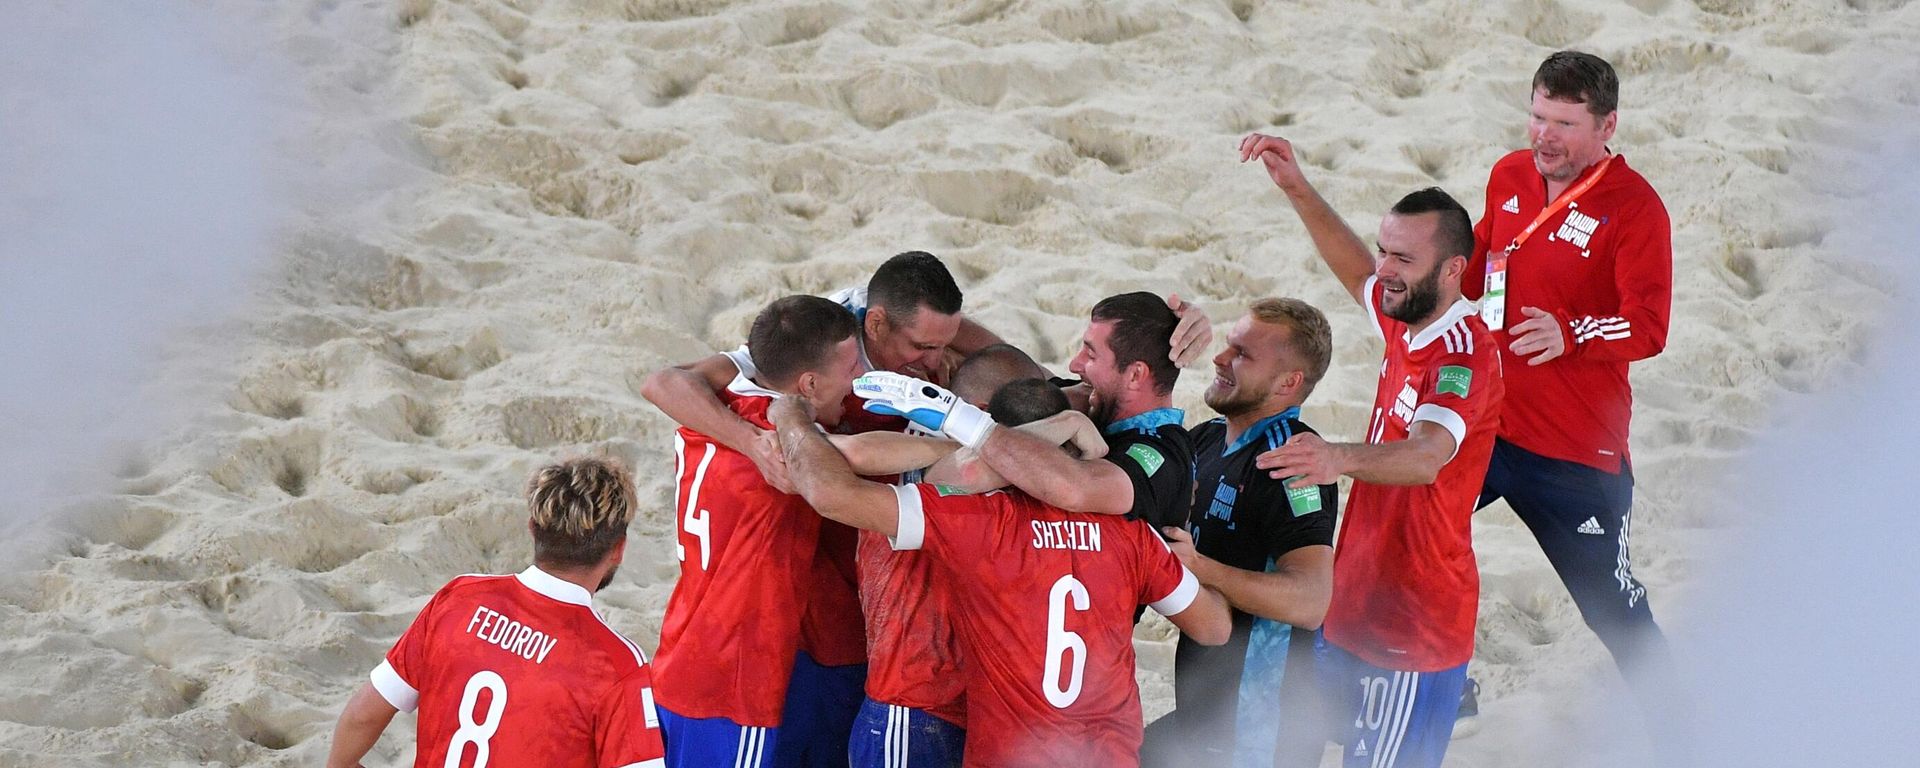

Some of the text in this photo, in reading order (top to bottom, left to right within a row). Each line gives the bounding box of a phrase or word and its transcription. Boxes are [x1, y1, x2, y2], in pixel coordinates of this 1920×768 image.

[1556, 223, 1591, 250] ПАРНИ
[1564, 209, 1600, 236] НАШИ
[1577, 526, 1605, 535] adidas
[466, 605, 558, 664] FEDOROV
[1042, 574, 1090, 709] 6
[443, 670, 508, 768] 8
[1355, 676, 1389, 731] 10
